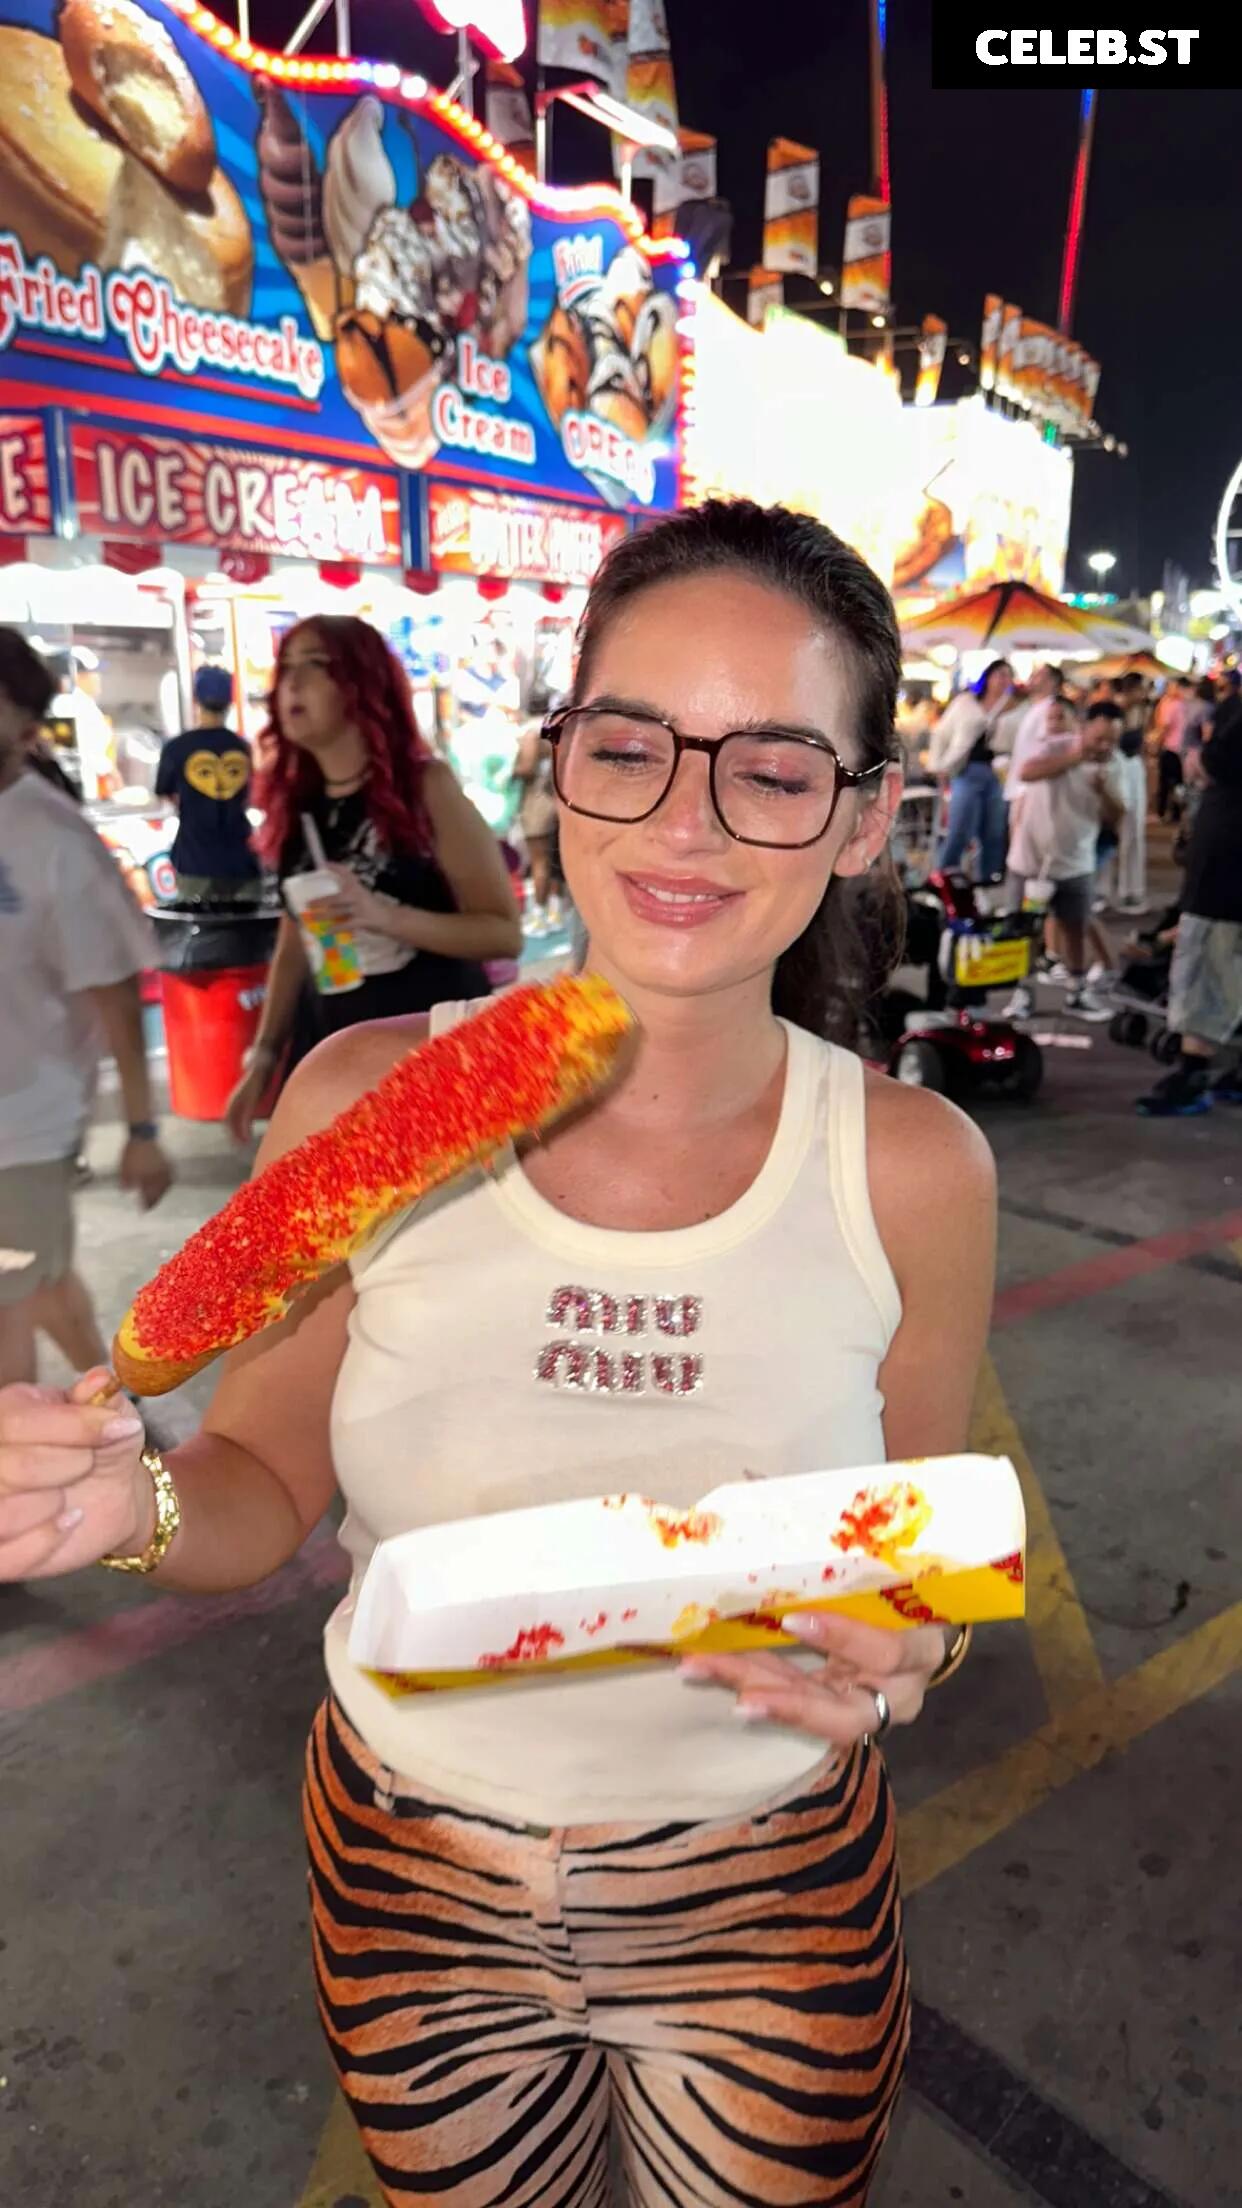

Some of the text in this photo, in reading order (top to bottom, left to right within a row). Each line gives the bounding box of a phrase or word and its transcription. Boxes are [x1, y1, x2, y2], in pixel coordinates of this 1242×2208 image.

[110, 279, 322, 392] Cheesecake
[461, 340, 511, 399] Ice
[438, 392, 534, 461] Cream
[98, 443, 187, 529] ICE
